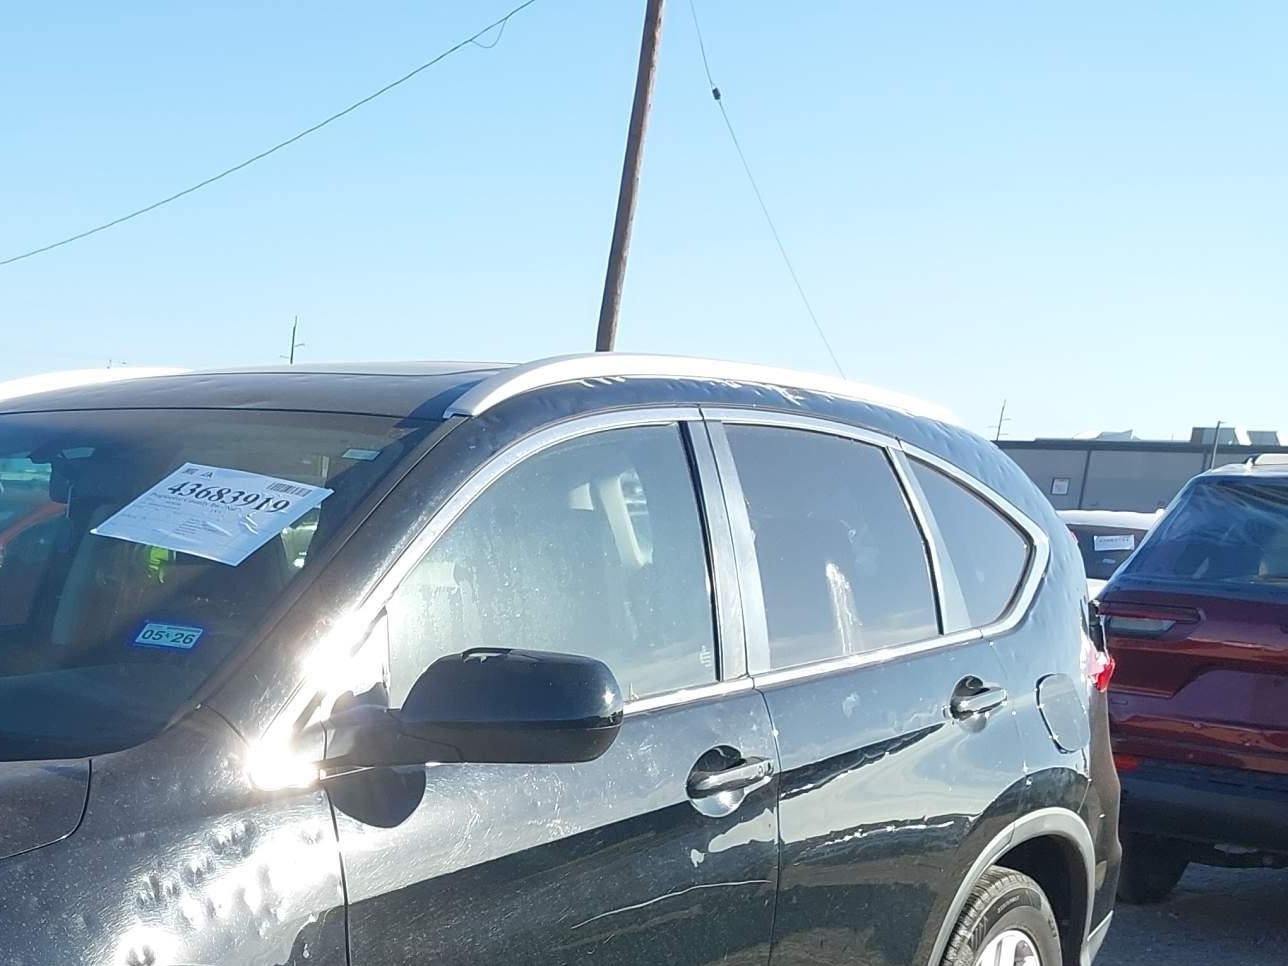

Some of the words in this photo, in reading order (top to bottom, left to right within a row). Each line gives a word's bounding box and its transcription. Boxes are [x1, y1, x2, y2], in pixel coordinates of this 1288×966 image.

[168, 481, 290, 513] 43683919
[142, 629, 166, 641] 05
[170, 632, 196, 645] 26
